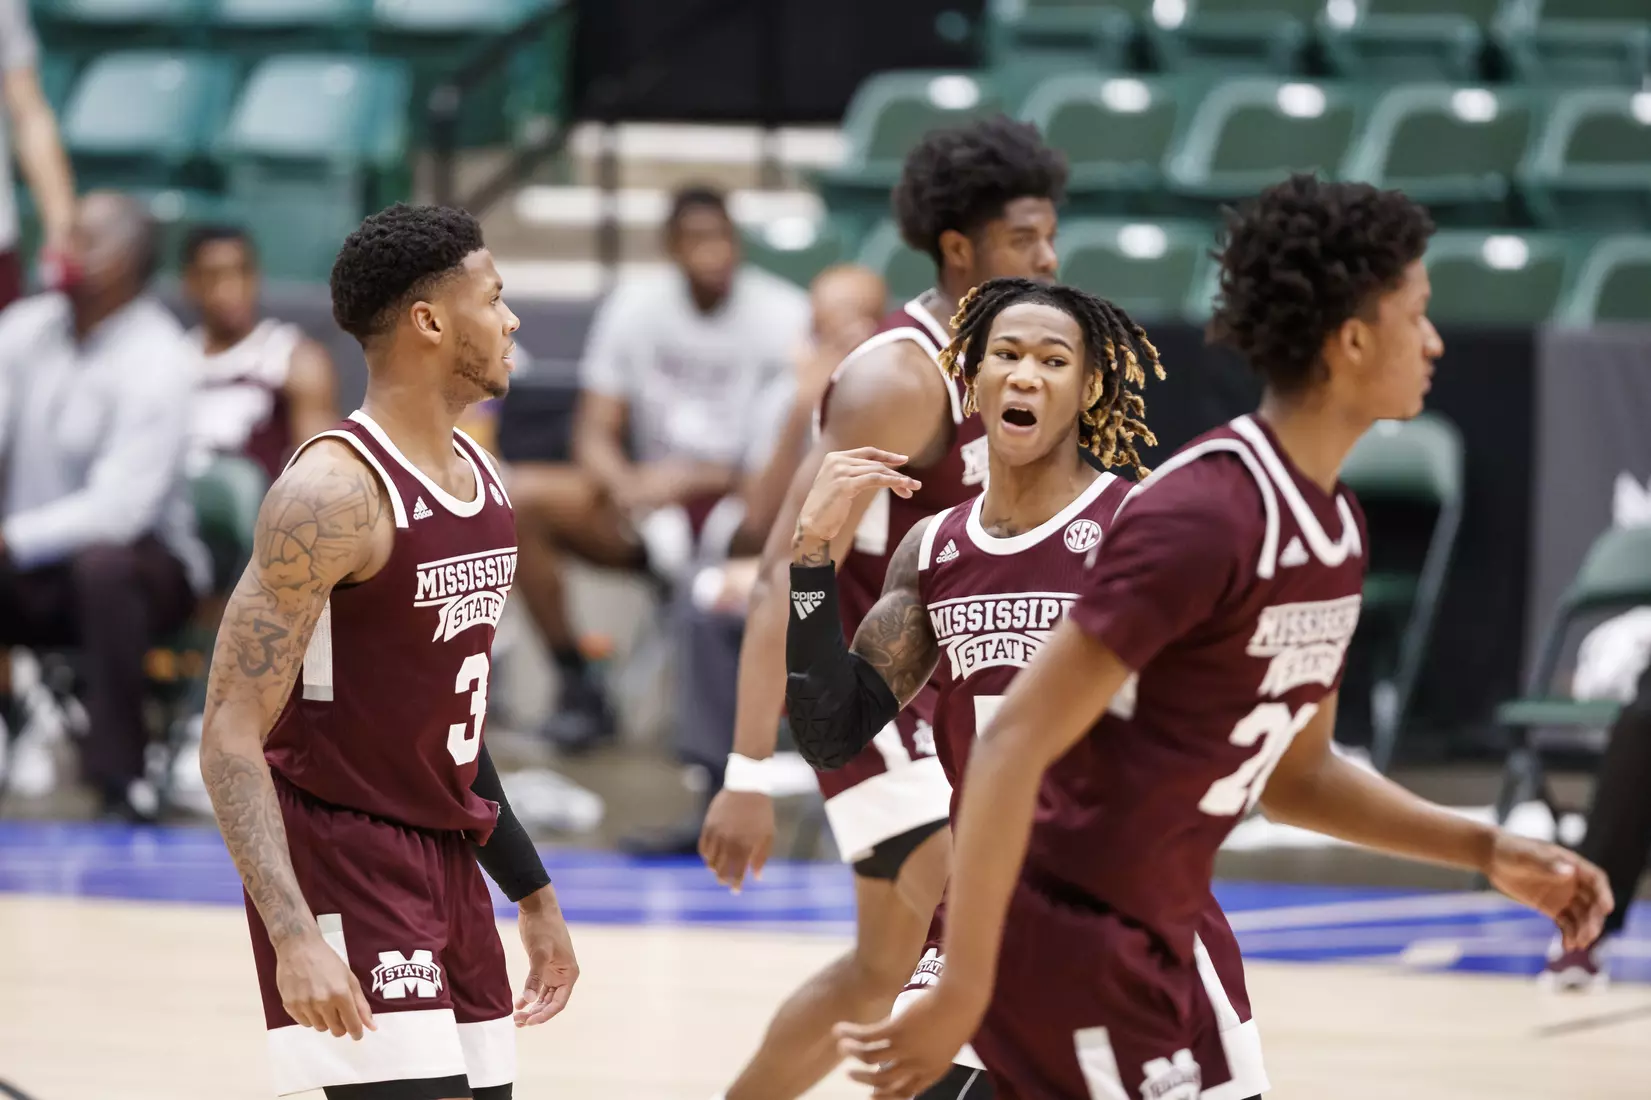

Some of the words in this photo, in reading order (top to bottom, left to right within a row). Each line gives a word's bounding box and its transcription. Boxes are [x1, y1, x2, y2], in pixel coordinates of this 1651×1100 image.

[1067, 521, 1099, 550] SEC
[936, 550, 960, 564] adidas
[791, 590, 825, 601] adida
[453, 597, 500, 629] STATE
[447, 652, 490, 766] 3
[385, 964, 432, 981] STATE
